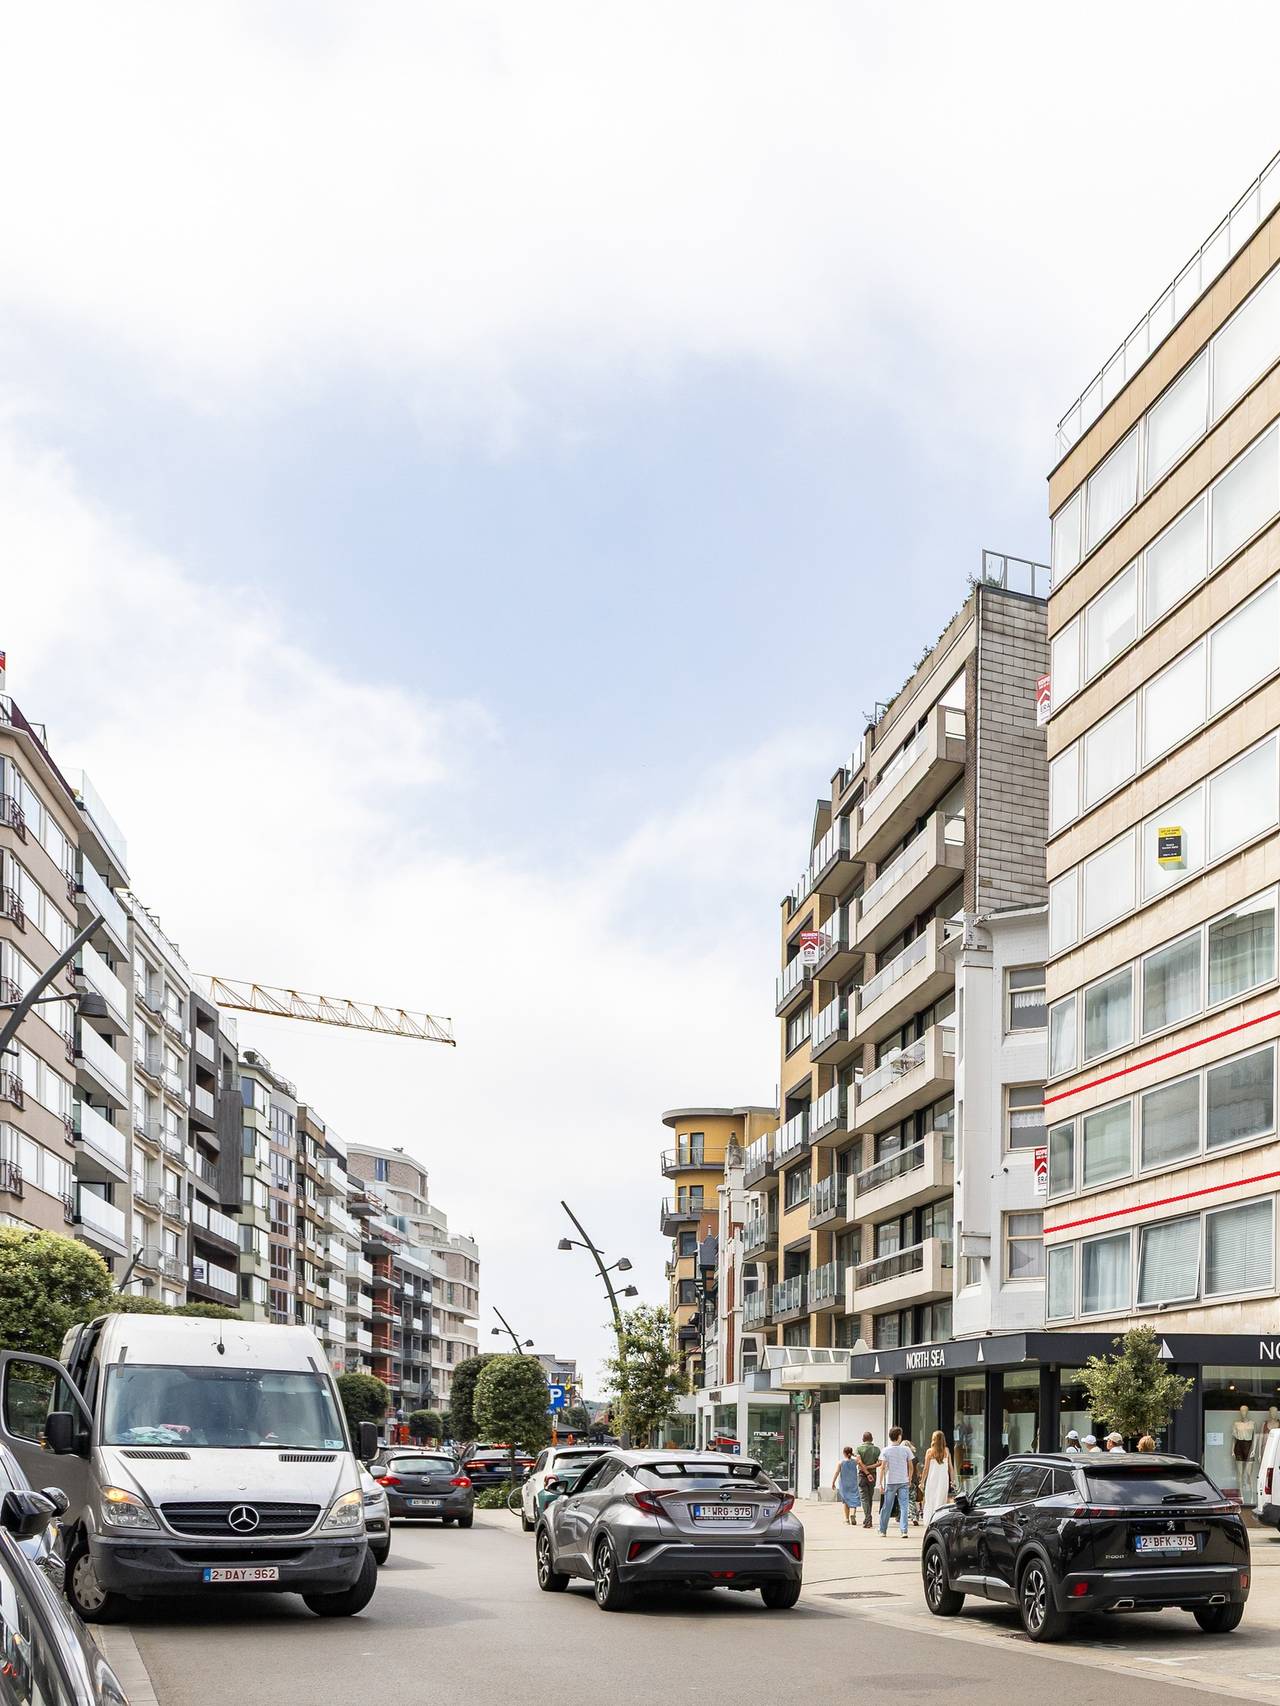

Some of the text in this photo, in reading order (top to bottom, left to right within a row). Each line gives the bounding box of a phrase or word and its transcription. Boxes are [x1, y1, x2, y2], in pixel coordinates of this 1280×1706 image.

[906, 1349, 946, 1370] NORTH SEA
[550, 1388, 562, 1405] P
[702, 1507, 751, 1516] 1-WRG-975
[1142, 1536, 1194, 1548] 2-BFK-379
[211, 1569, 276, 1580] 2-DAY-962
